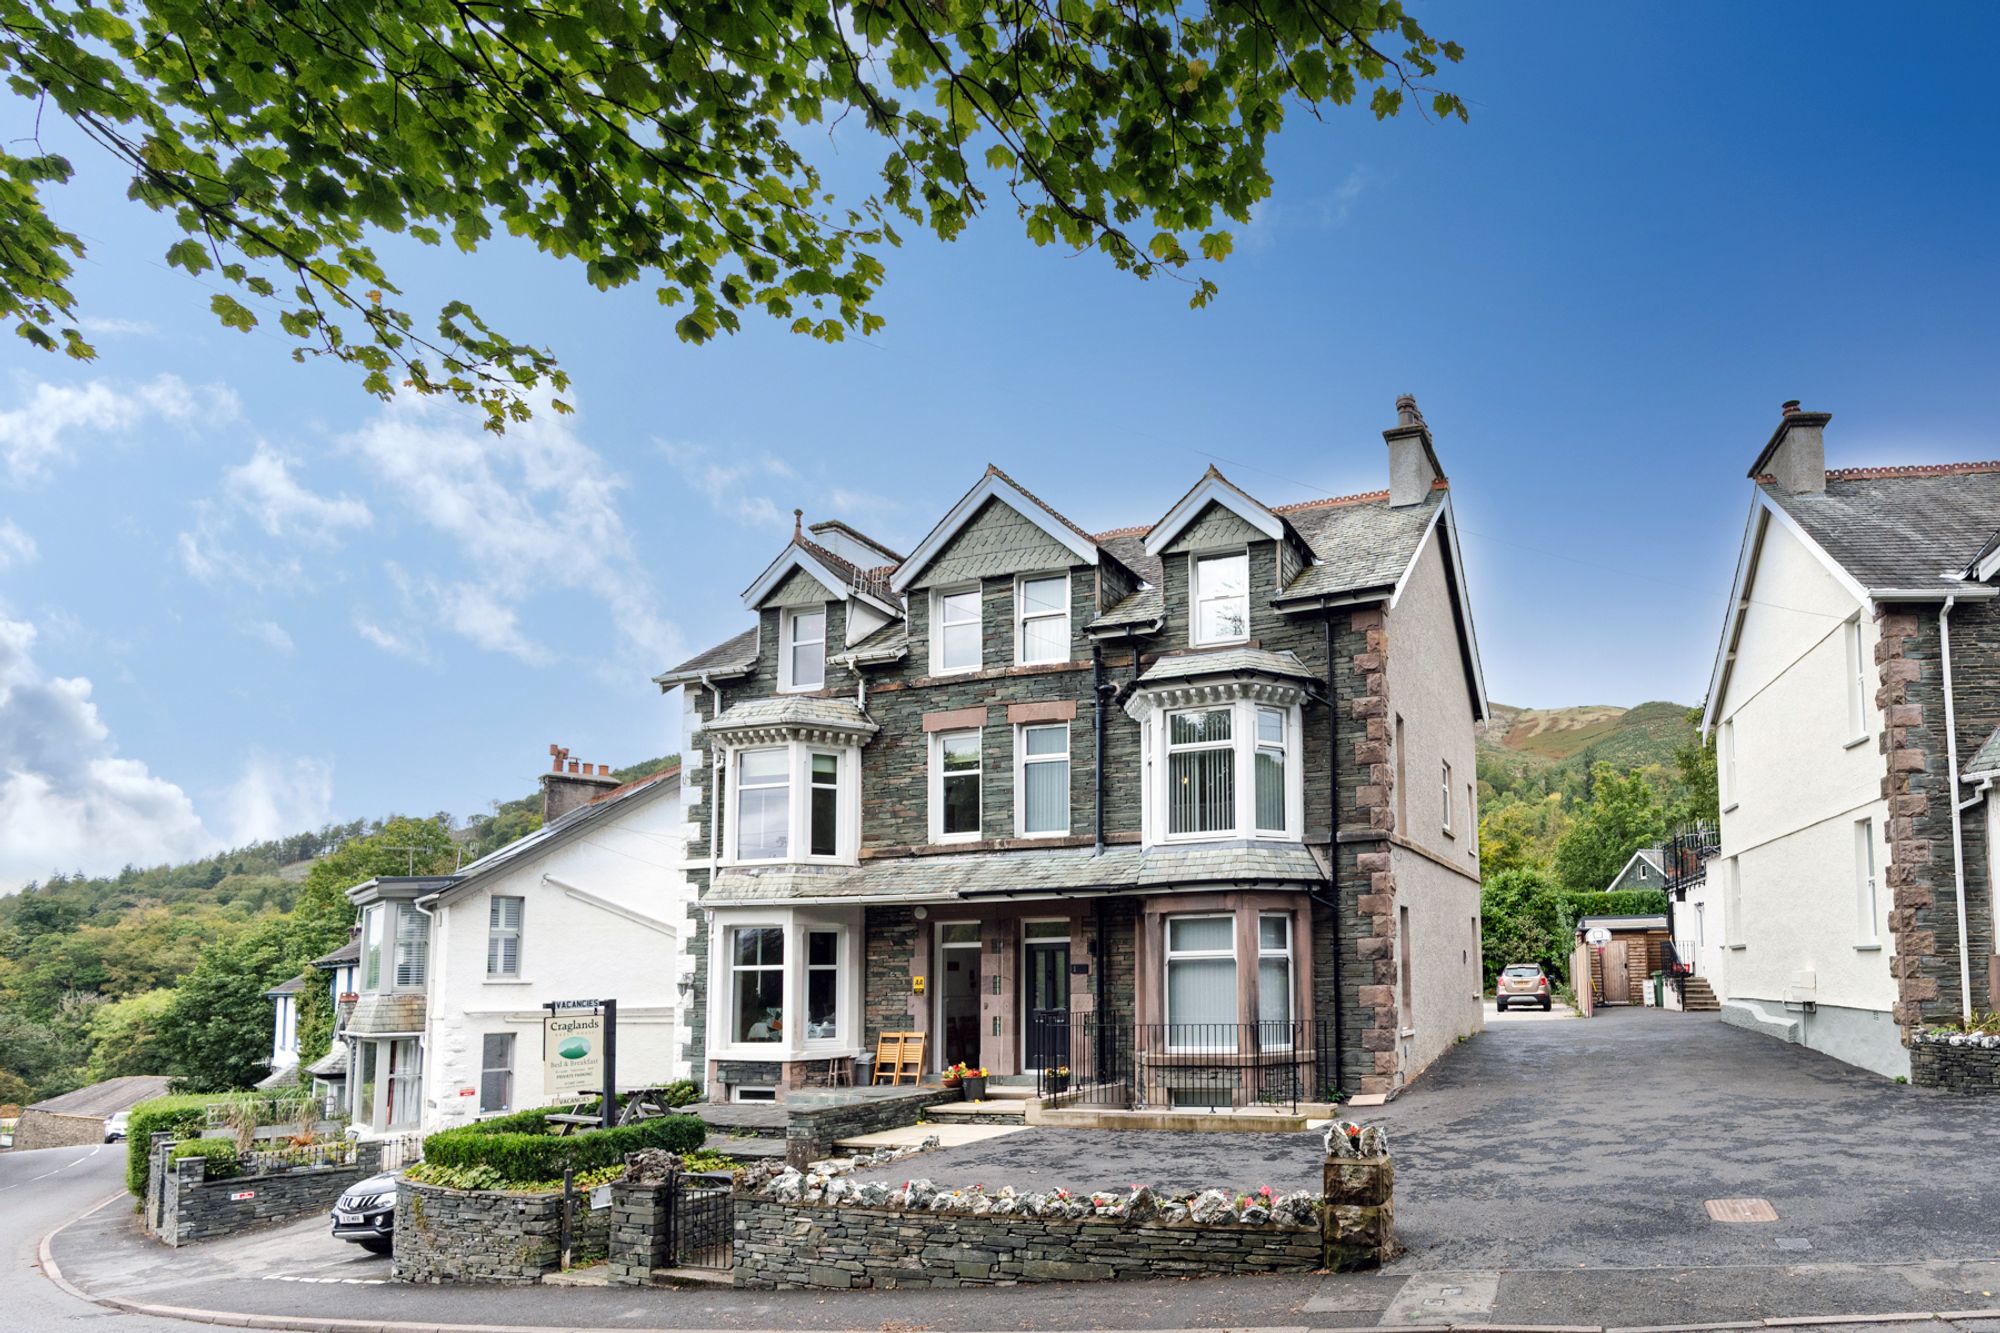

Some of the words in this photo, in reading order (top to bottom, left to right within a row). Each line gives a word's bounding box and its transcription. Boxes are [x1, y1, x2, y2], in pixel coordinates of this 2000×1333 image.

[556, 1000, 599, 1009] VACANCIES
[550, 1019, 599, 1032] Craglands
[559, 1096, 590, 1105] VACANCIES
